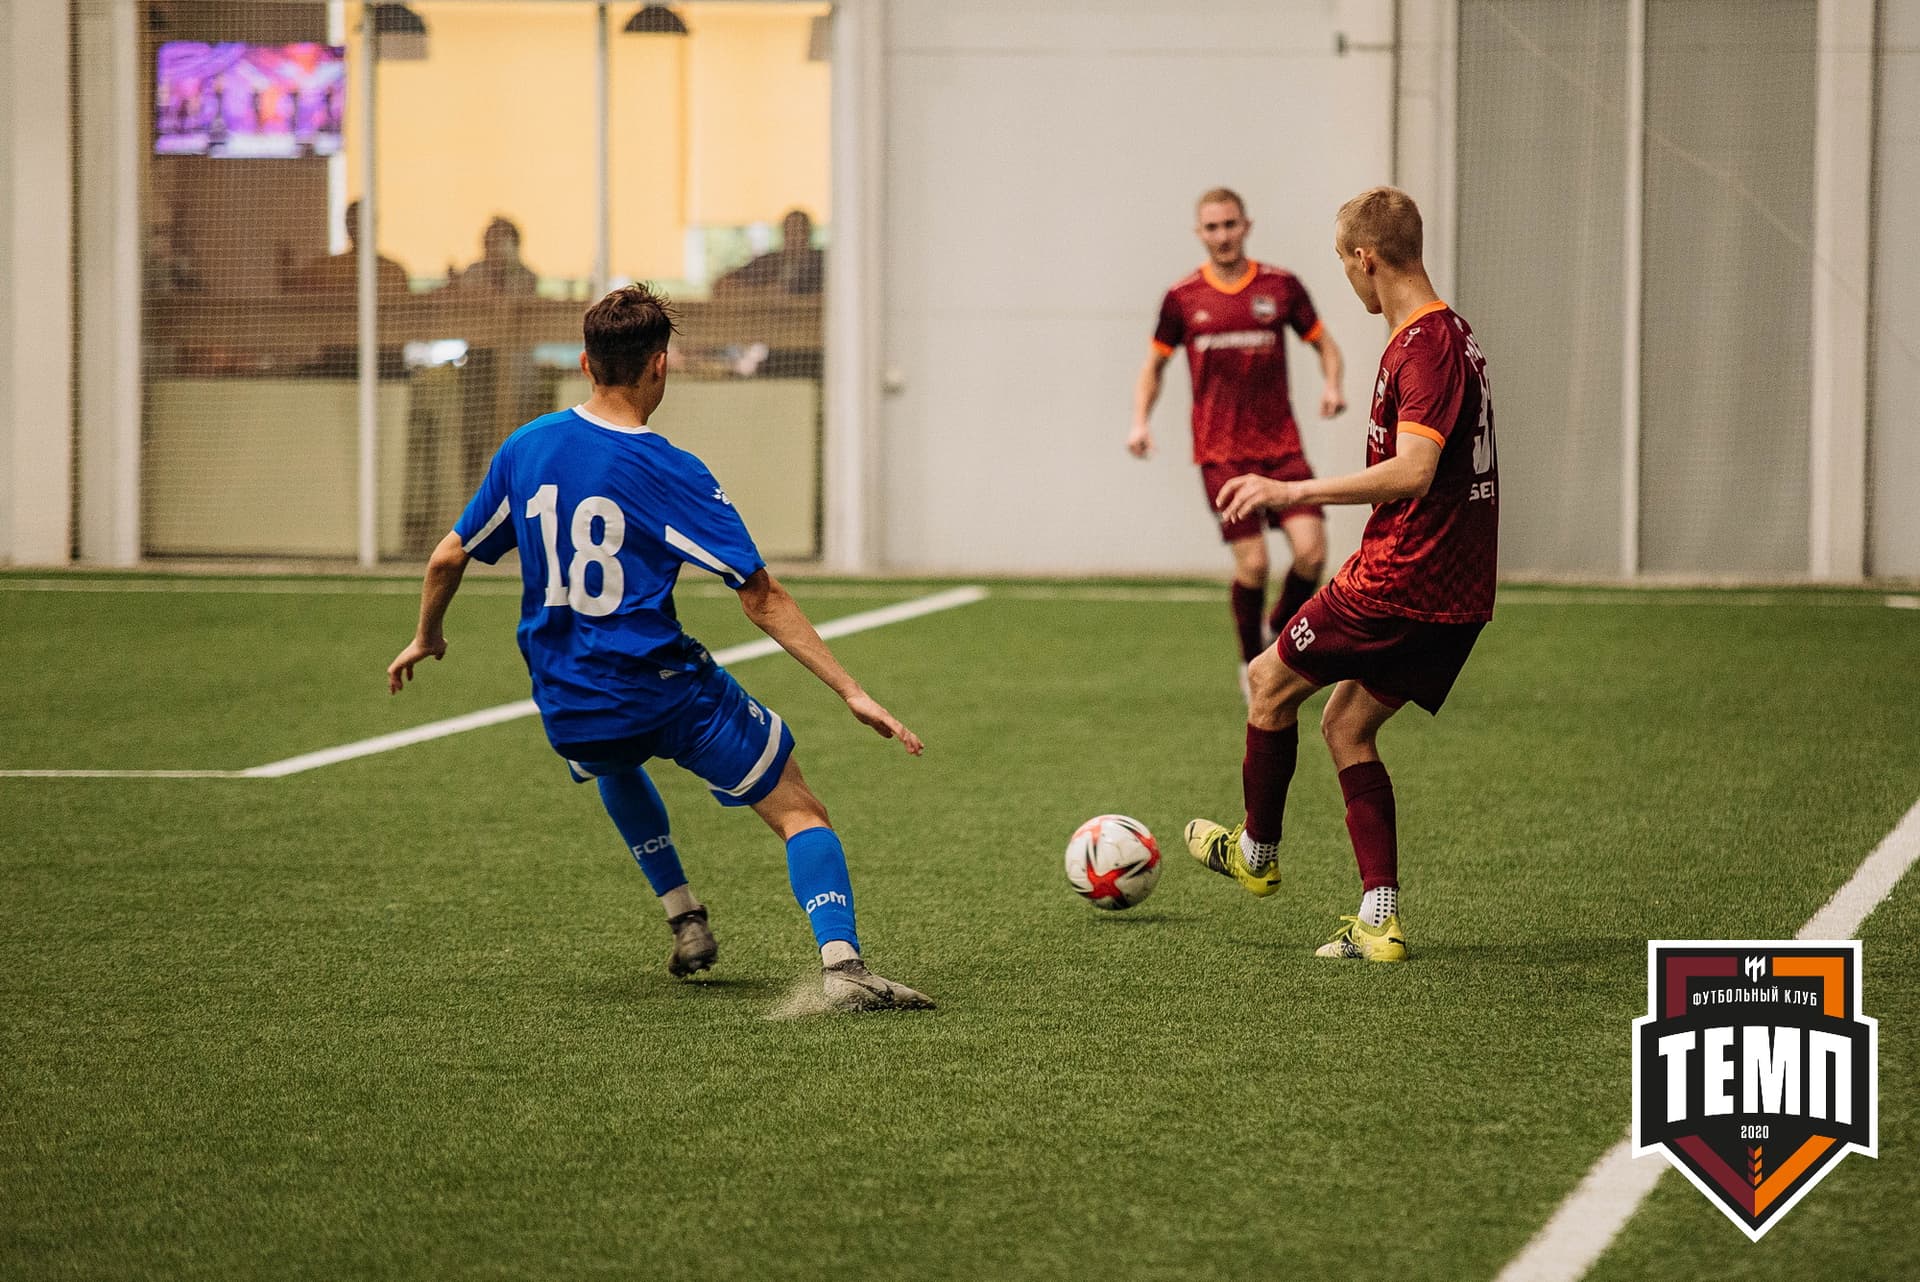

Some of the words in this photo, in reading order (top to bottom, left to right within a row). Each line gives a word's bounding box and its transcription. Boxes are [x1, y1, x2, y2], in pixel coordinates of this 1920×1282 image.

[526, 484, 626, 617] 18
[1290, 616, 1316, 652] 33
[631, 833, 674, 861] FCD
